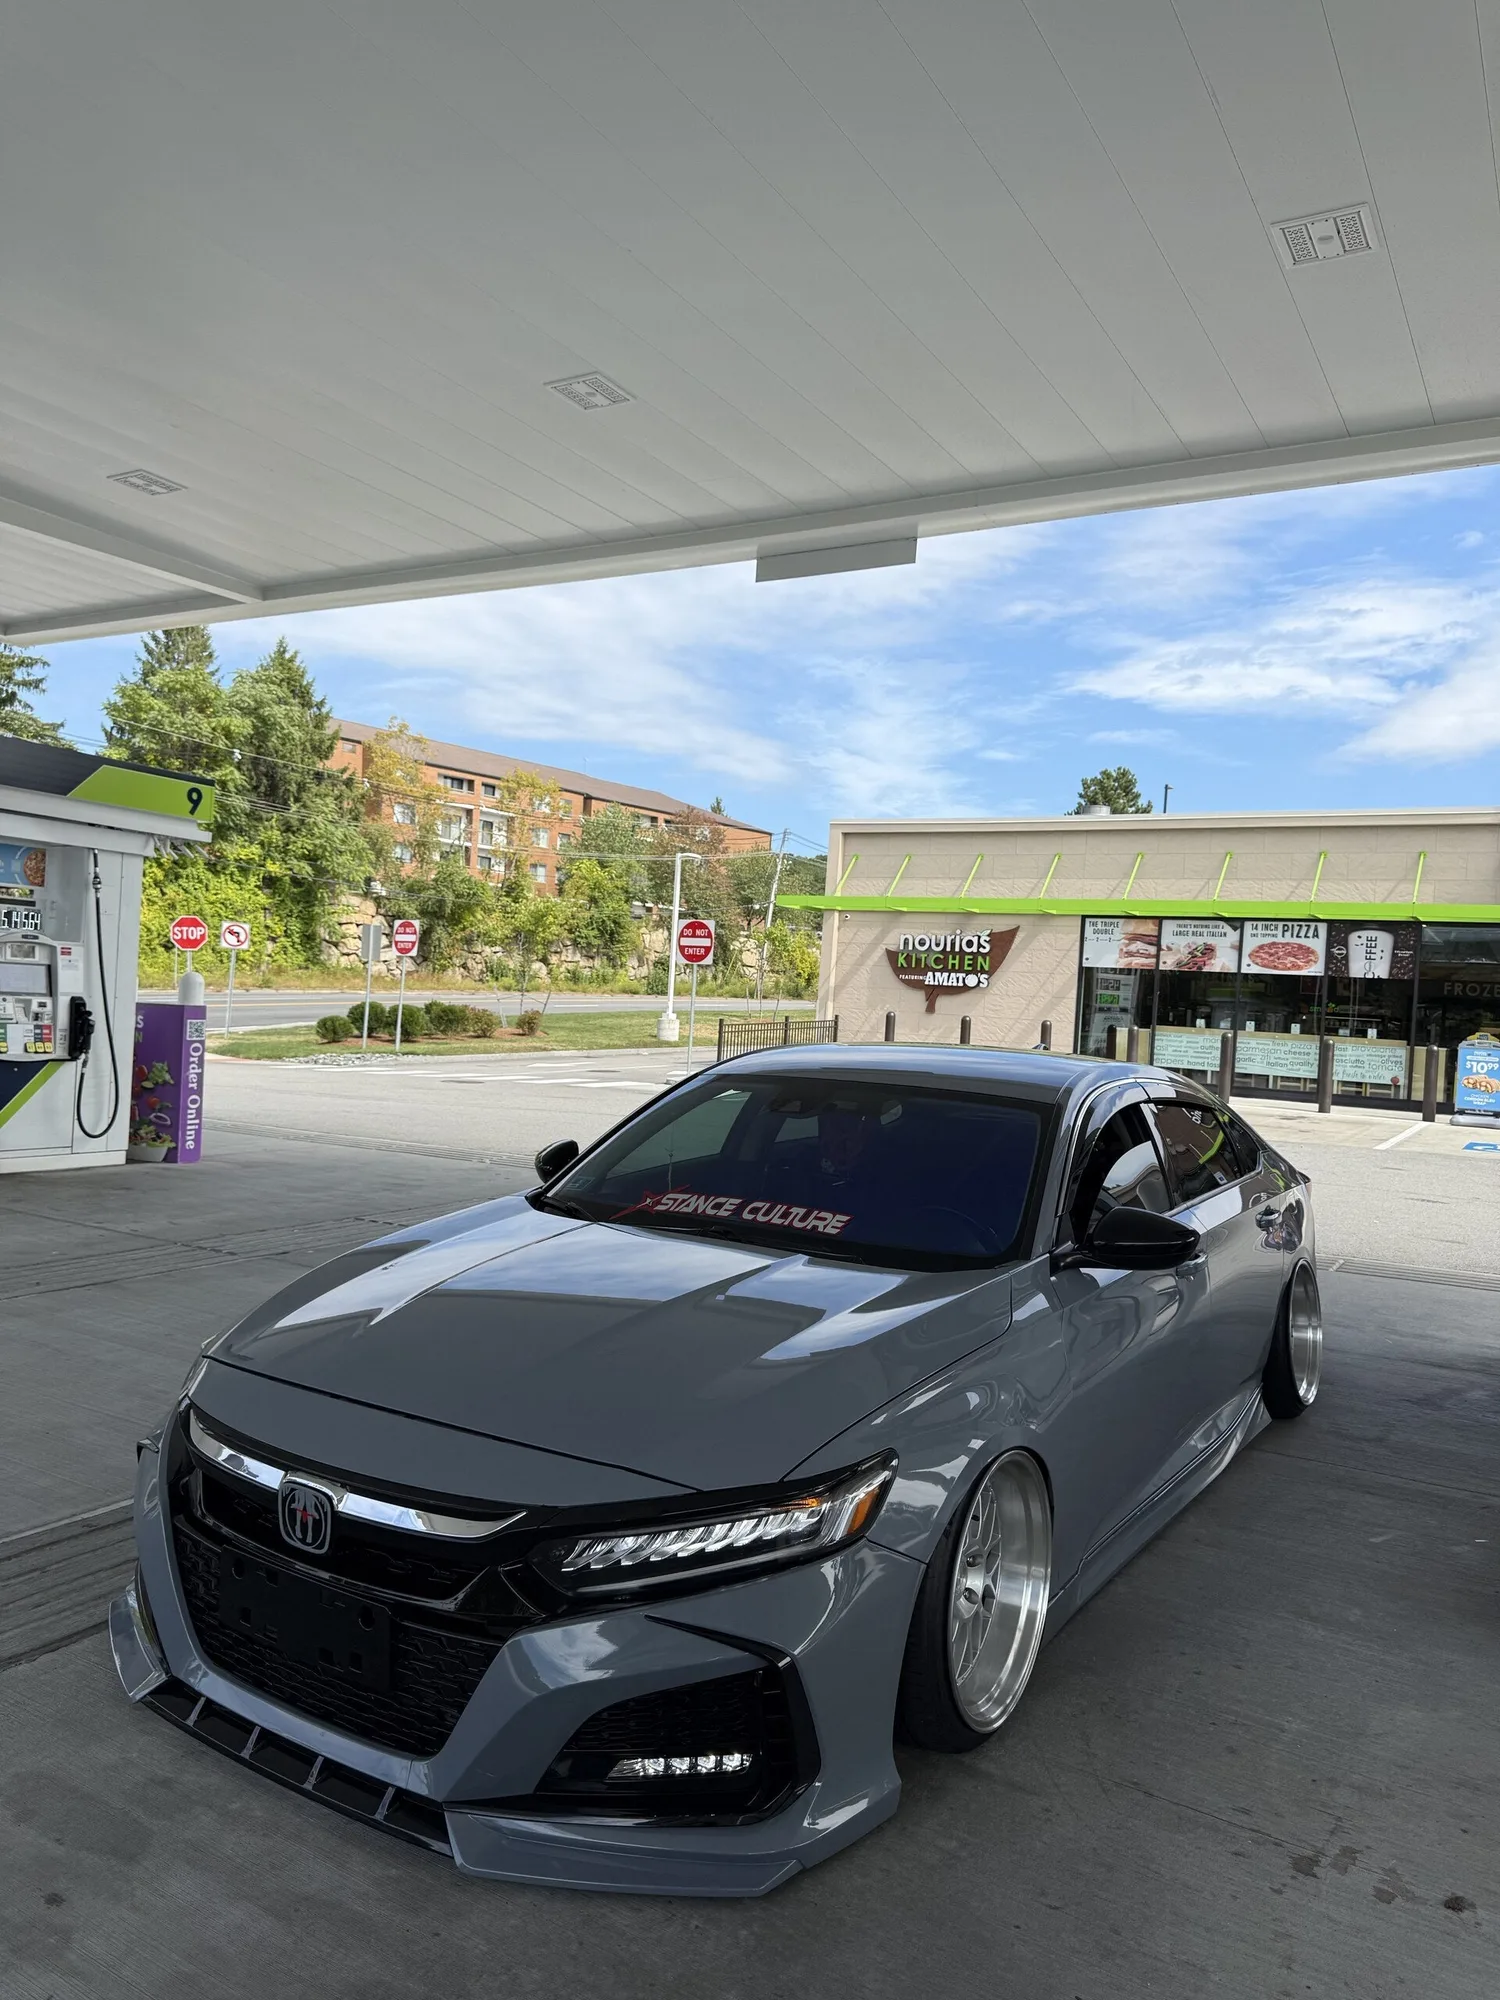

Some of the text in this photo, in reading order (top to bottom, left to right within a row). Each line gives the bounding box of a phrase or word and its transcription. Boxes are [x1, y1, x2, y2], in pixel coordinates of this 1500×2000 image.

[186, 786, 203, 816] 9
[1088, 920, 1120, 929] THE TRIPLE
[173, 926, 205, 940] STOP
[683, 928, 709, 937] DO NOT
[1092, 928, 1115, 936] DOUBLE
[1250, 923, 1320, 940] 14 INCH PIZZA
[684, 947, 705, 955] ENTER
[897, 953, 991, 971] KITCHEN
[1283, 1049, 1311, 1057] cheese
[1155, 1057, 1184, 1066] eppers
[1236, 1056, 1256, 1064] garlic
[1288, 1060, 1315, 1069] quality
[1380, 1058, 1403, 1066] olives
[1367, 1062, 1404, 1072] tomato
[185, 1042, 203, 1150] Order Online
[653, 1193, 851, 1234] STANCE CULTURE
